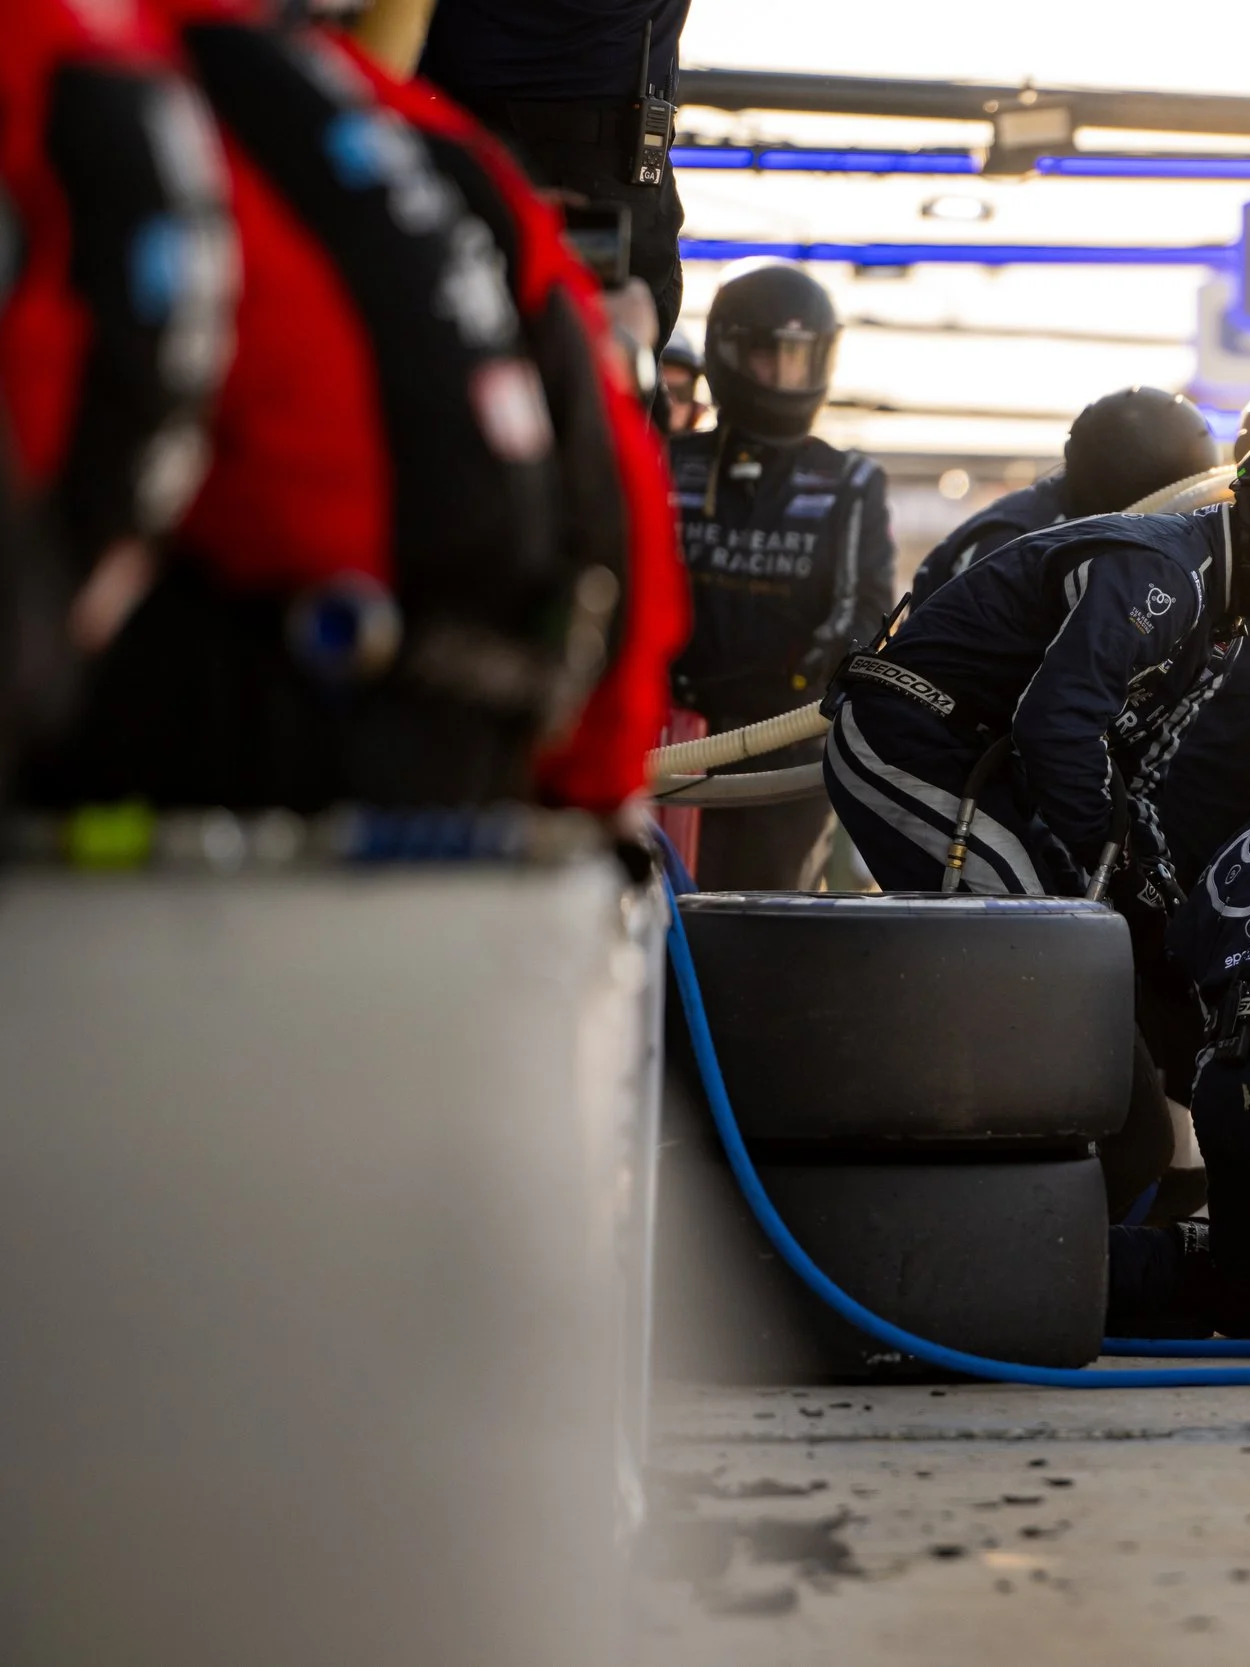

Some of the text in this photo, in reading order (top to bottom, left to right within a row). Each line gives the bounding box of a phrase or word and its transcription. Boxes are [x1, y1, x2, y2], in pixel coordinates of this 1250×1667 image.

[644, 171, 655, 181] GA
[727, 528, 818, 553] HEART
[711, 546, 813, 578] RACING
[851, 659, 952, 709] SPEEDCOM
